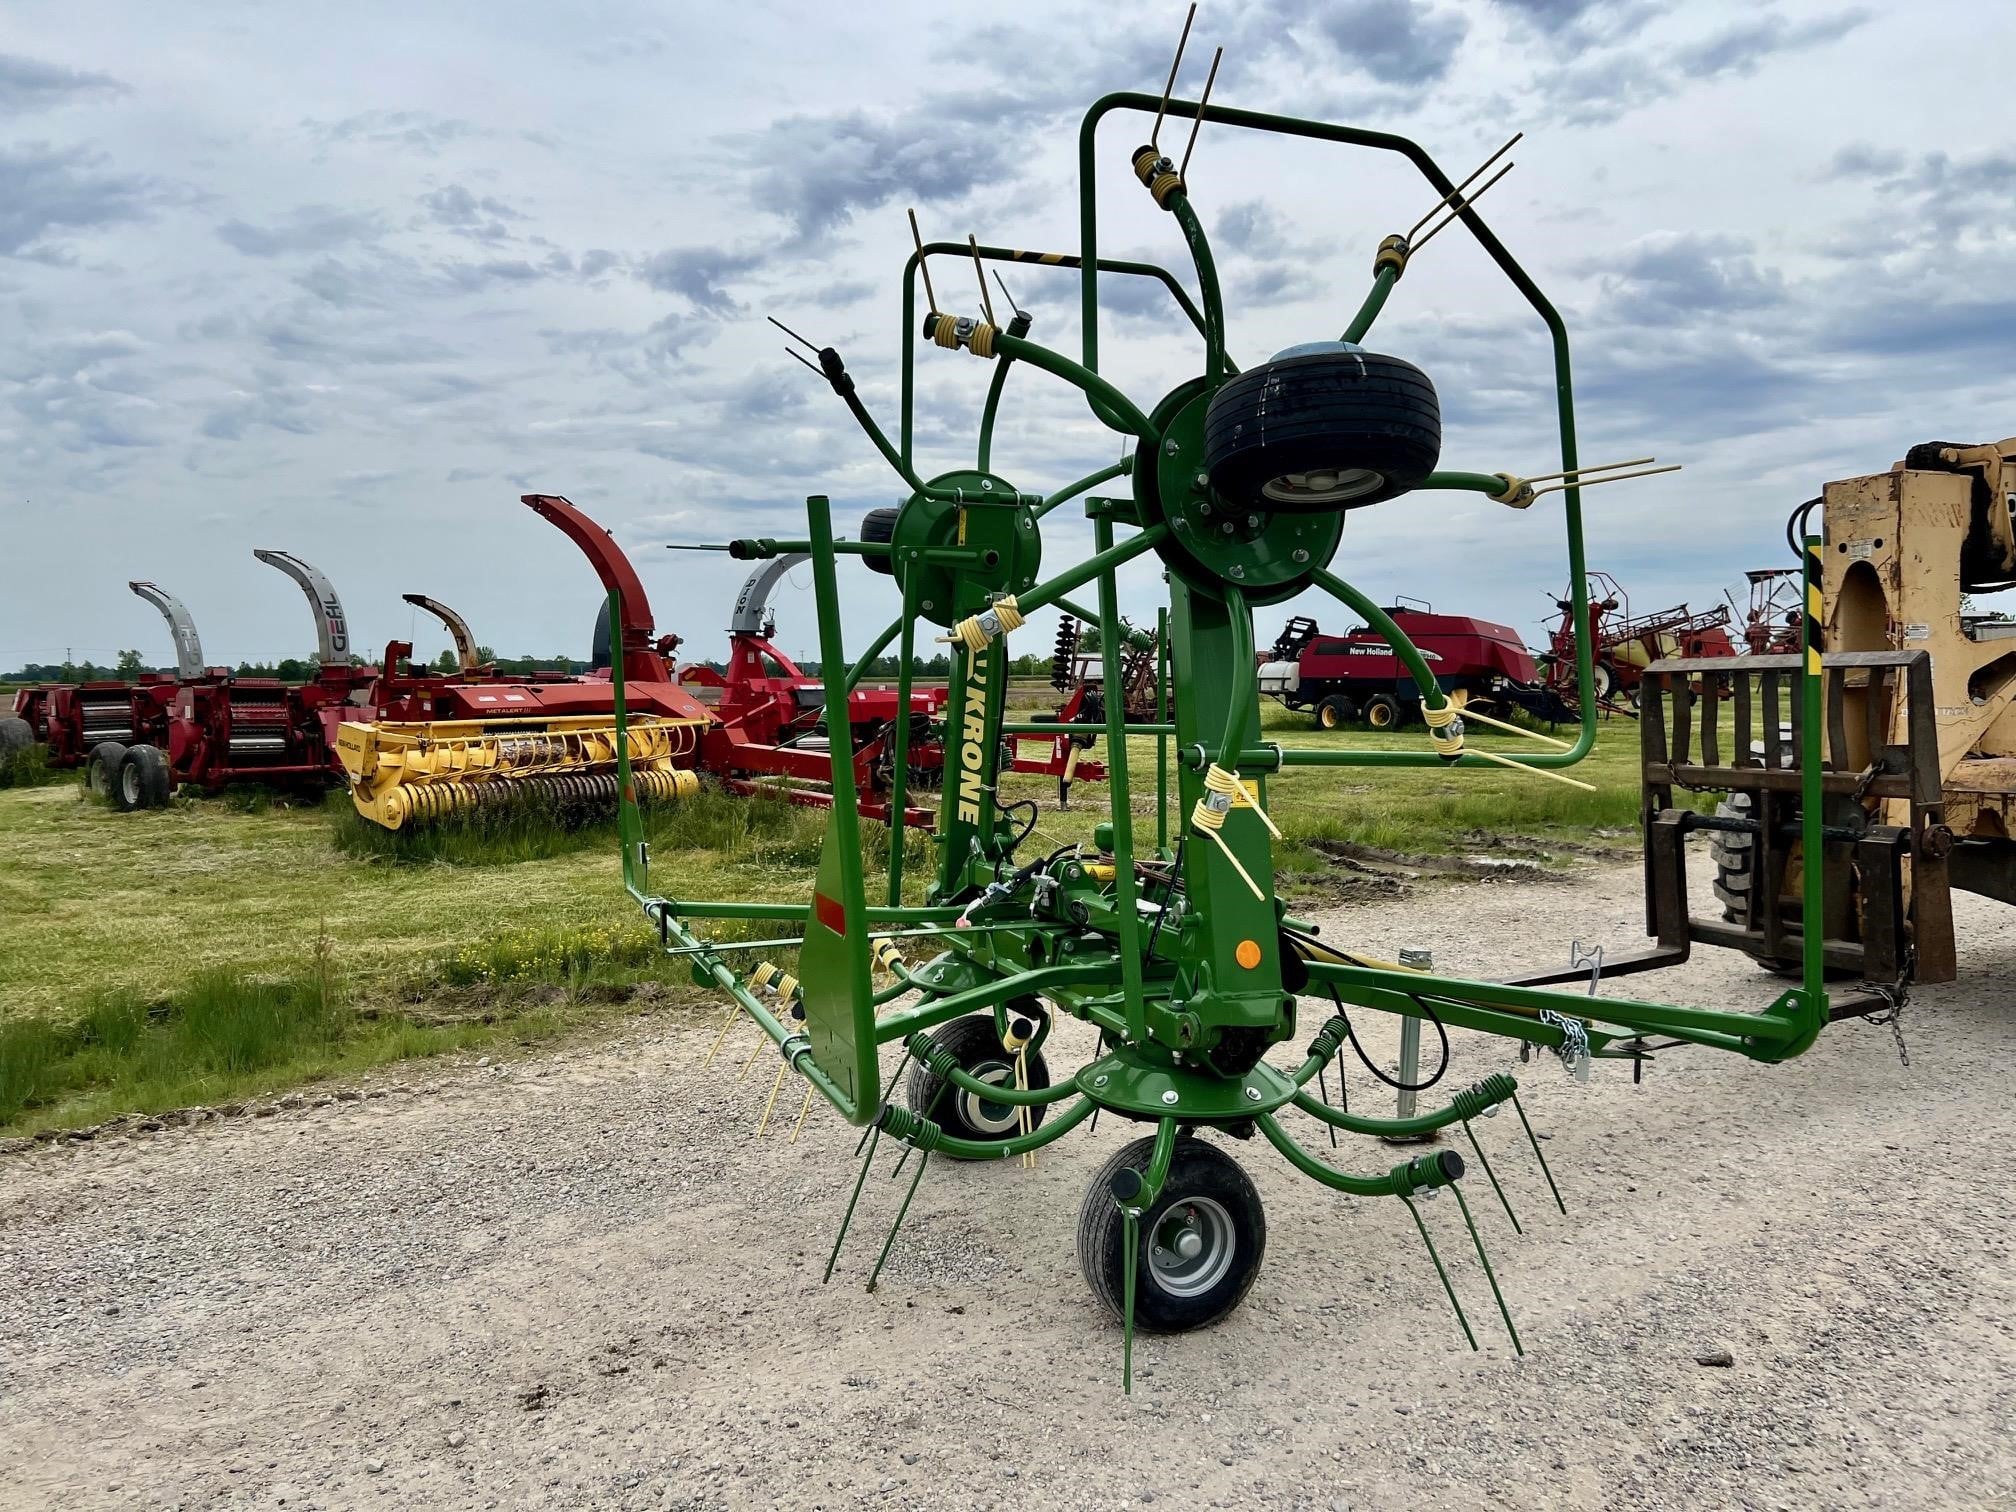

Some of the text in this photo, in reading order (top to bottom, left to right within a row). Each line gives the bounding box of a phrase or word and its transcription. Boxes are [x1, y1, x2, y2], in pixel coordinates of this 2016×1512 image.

[735, 578, 757, 615] DION
[323, 593, 346, 652] GEHL
[1349, 647, 1393, 656] New Holland
[957, 686, 986, 826] KRONE
